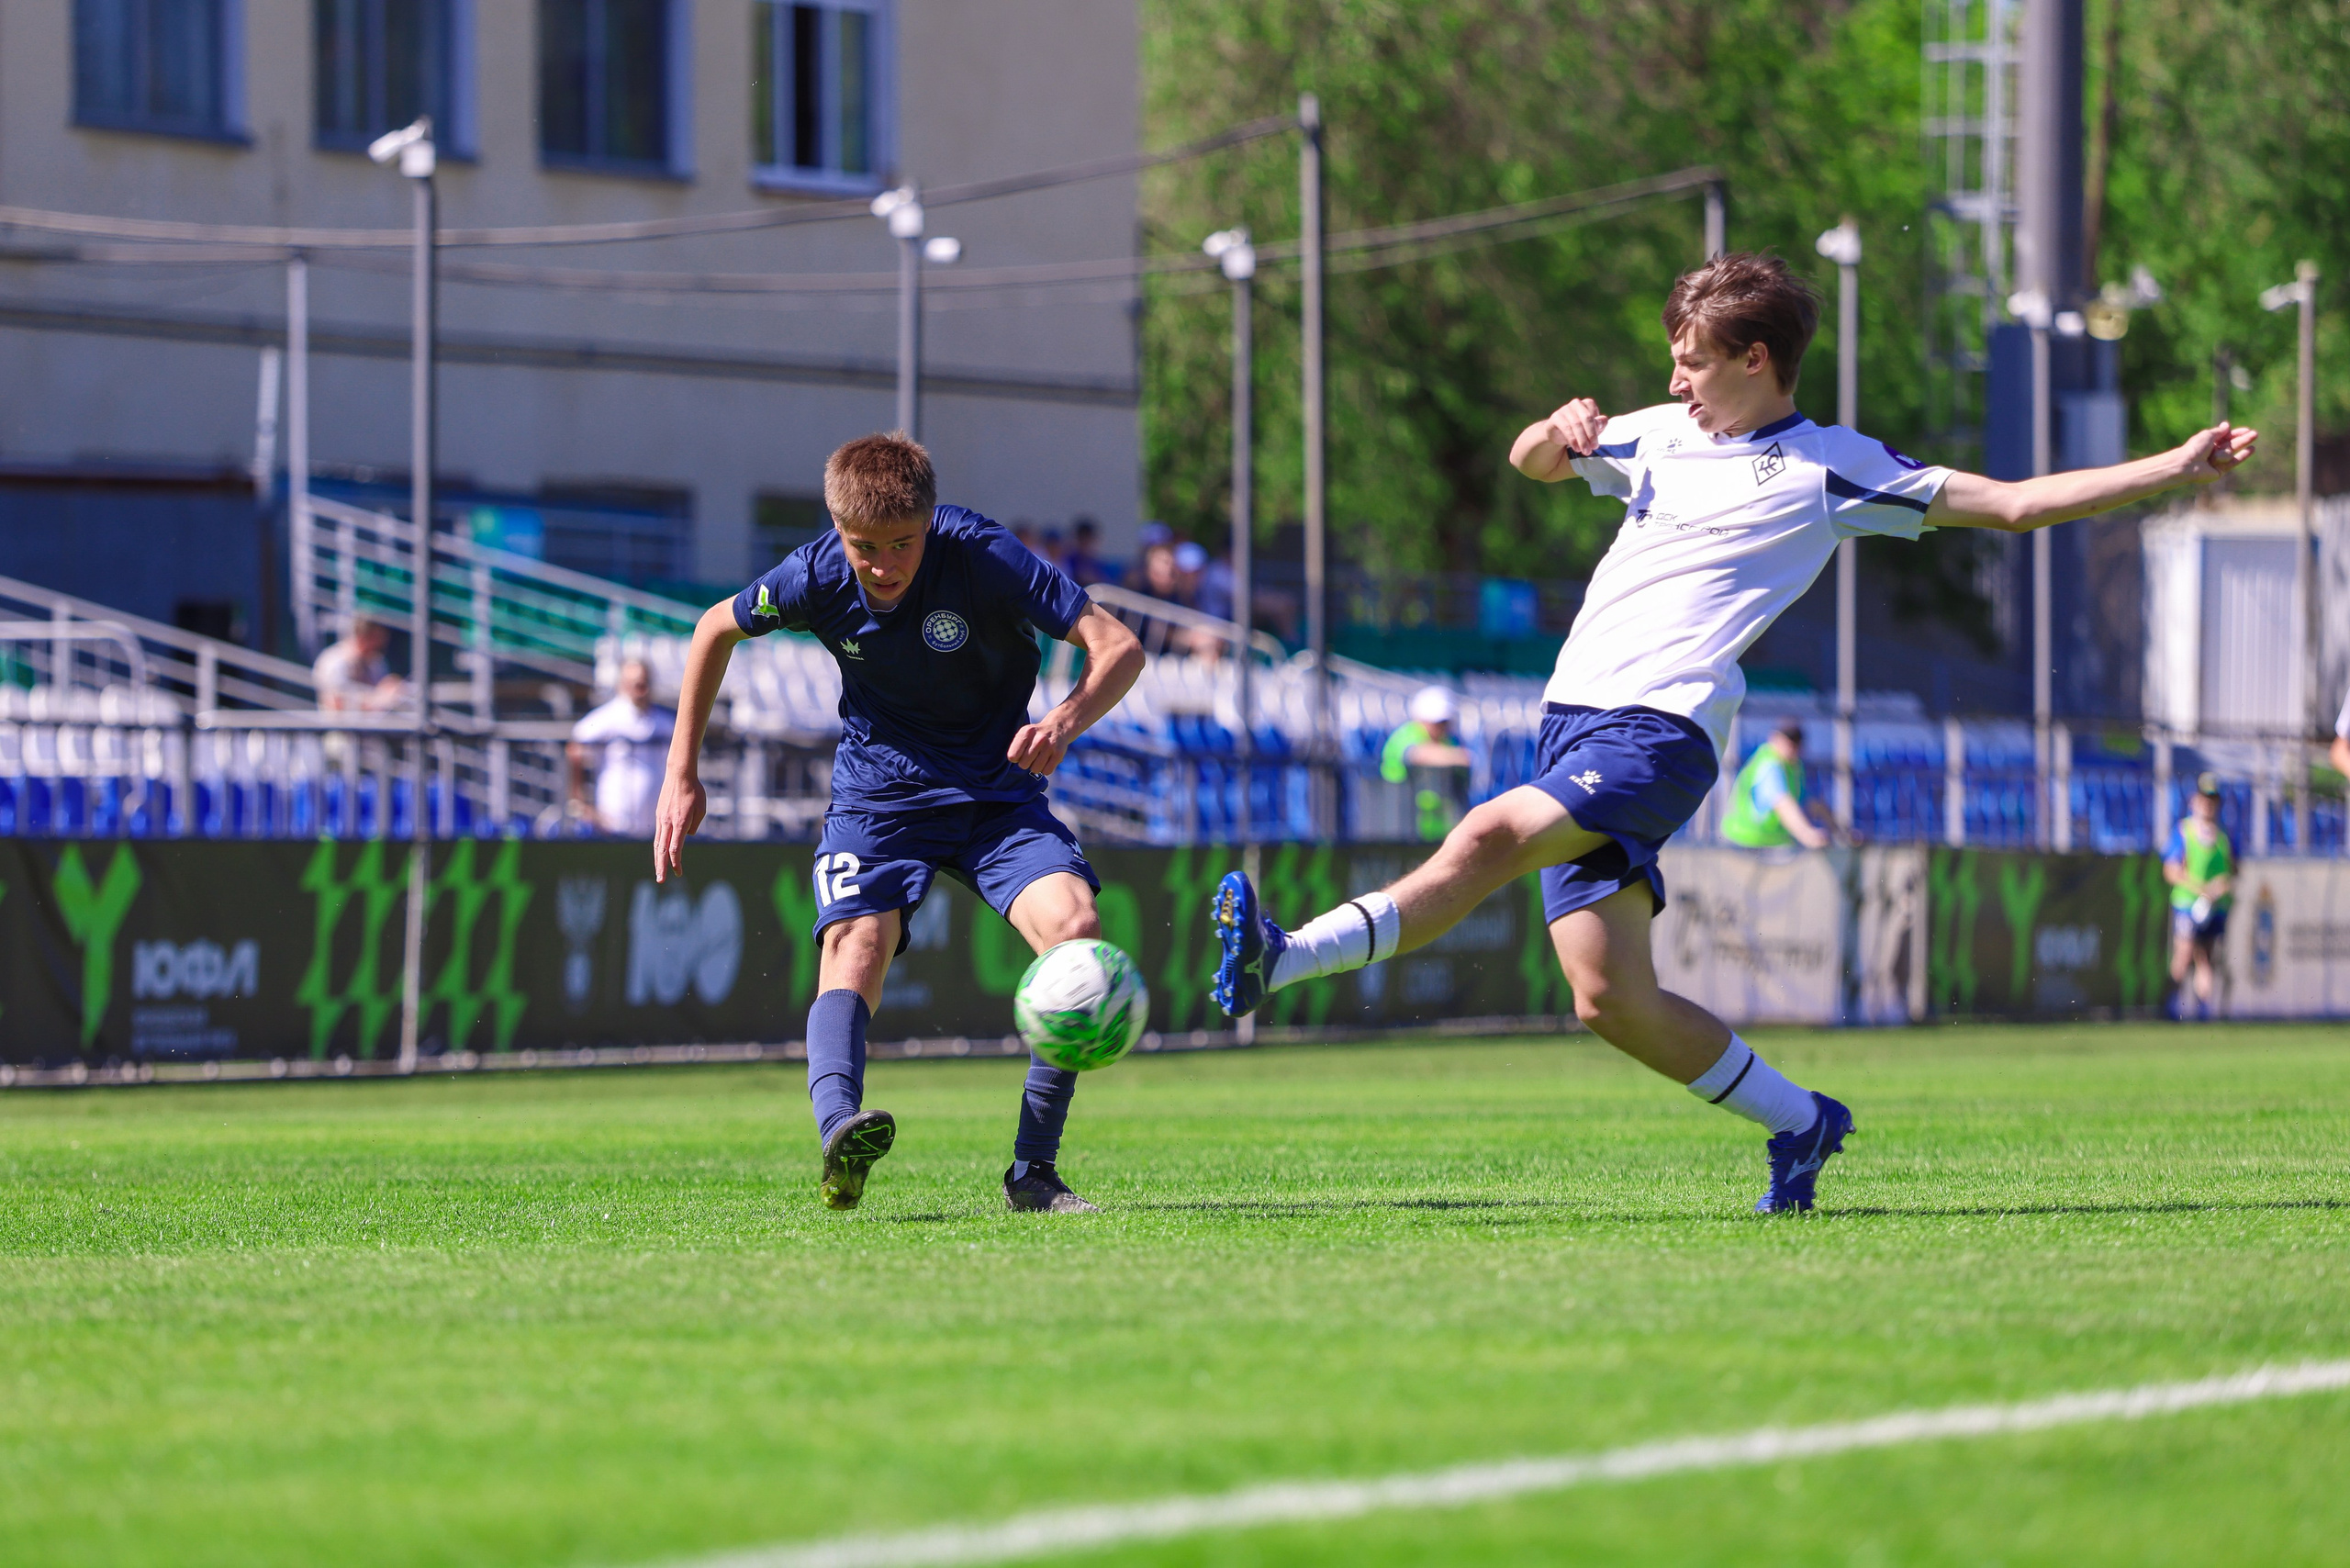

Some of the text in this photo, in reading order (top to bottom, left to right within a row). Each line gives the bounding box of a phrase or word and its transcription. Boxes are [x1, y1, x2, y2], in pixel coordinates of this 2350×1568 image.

[925, 612, 963, 633] ОРЕНБУРГ
[1568, 775, 1596, 795] KELME
[814, 851, 861, 908] 12
